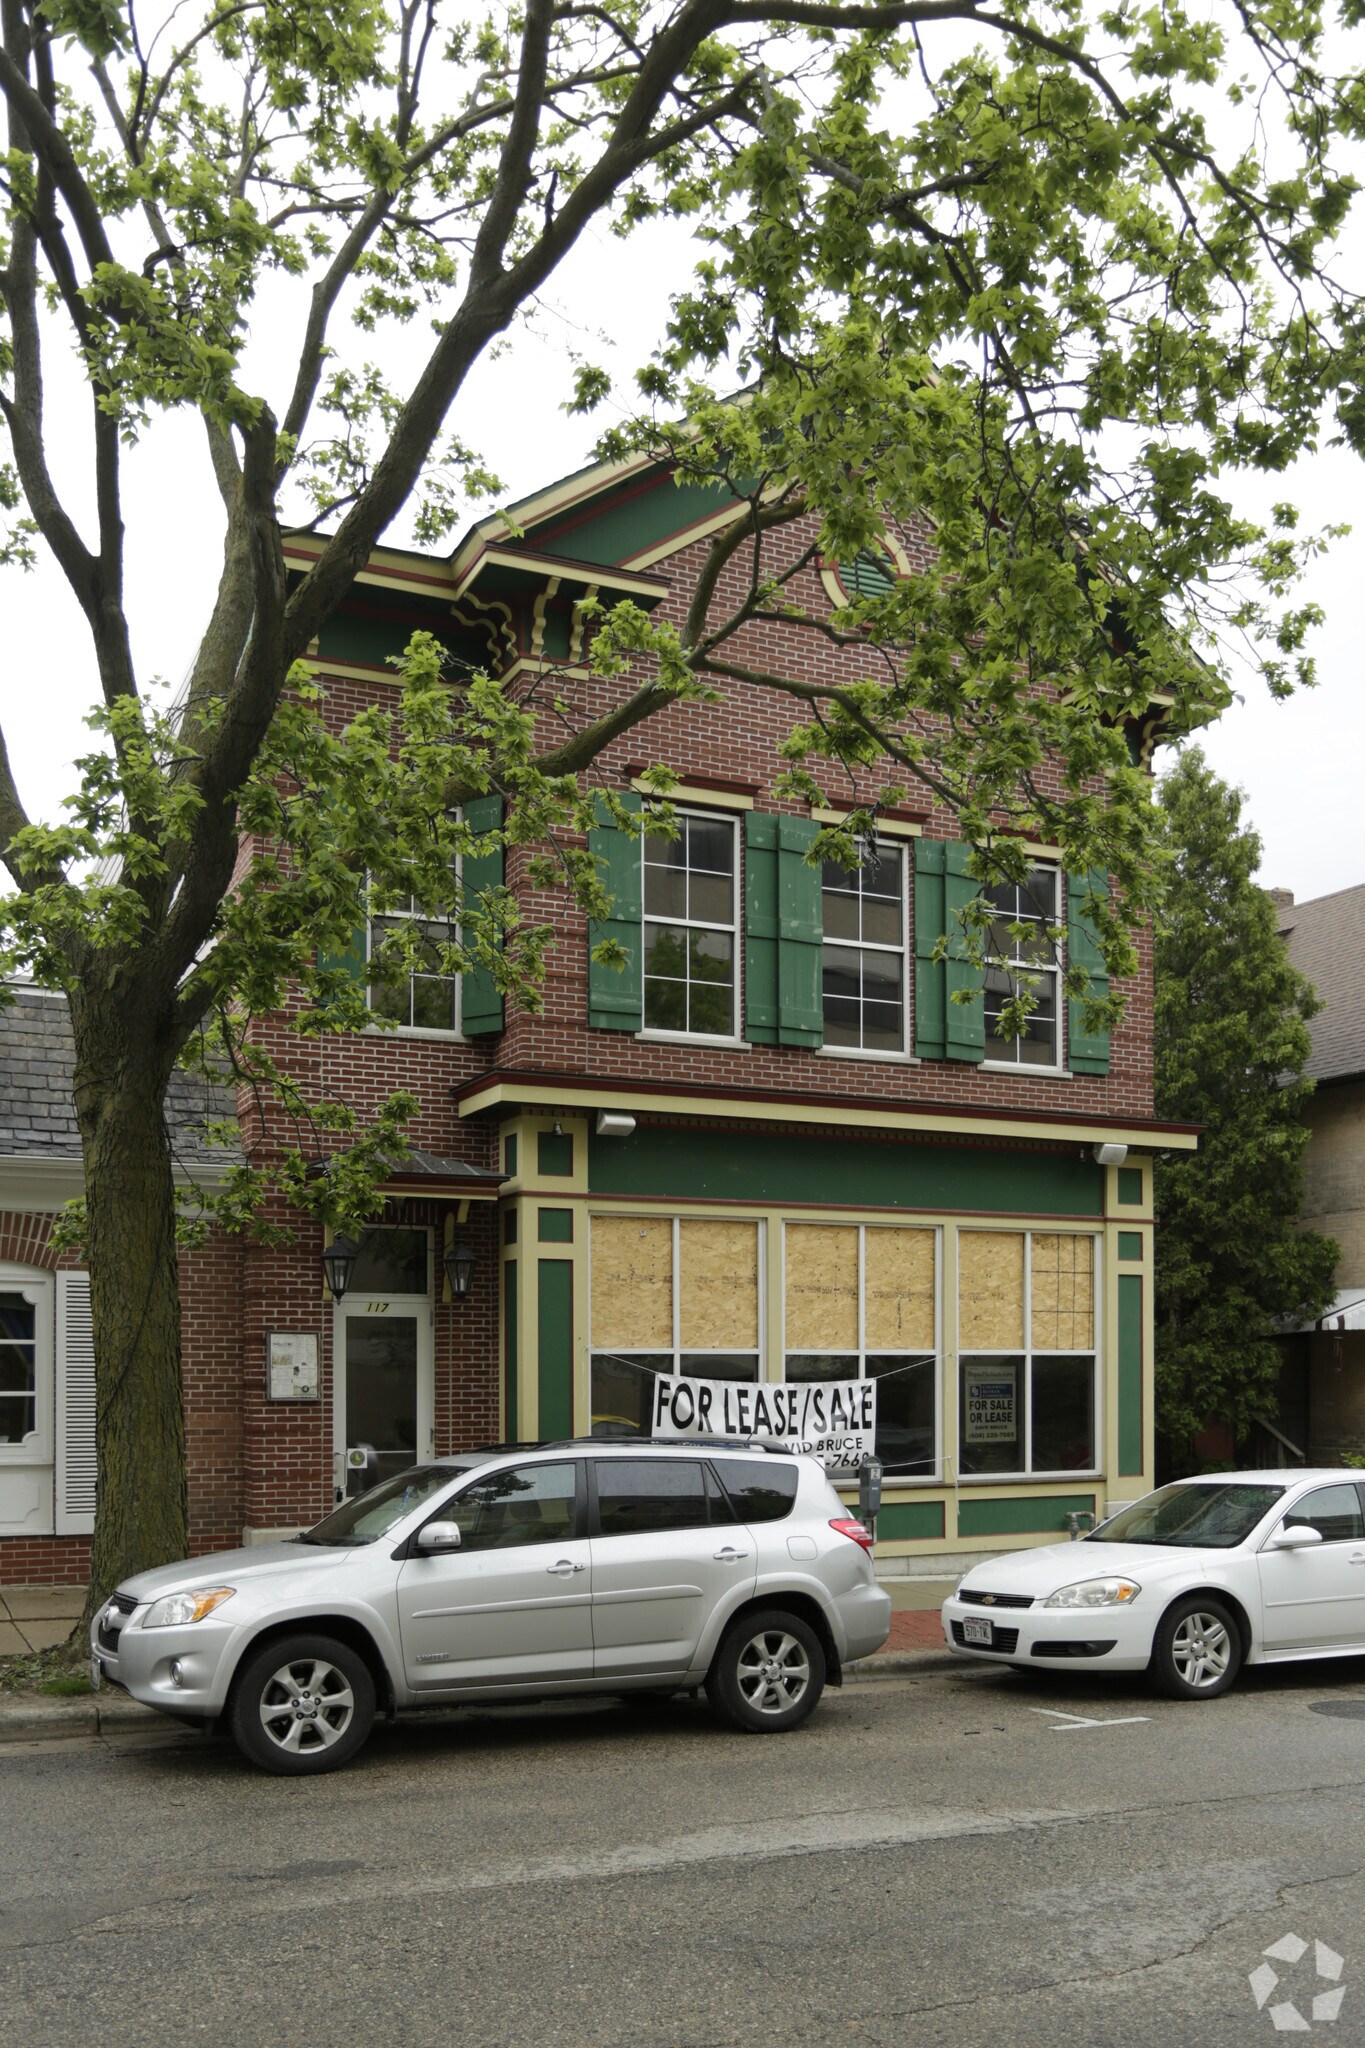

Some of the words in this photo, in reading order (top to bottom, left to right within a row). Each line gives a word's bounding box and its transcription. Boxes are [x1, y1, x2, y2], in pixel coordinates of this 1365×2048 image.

[367, 1303, 389, 1312] 117
[656, 1380, 713, 1433] FOR
[724, 1384, 872, 1440] LEASE/SALE
[969, 1400, 987, 1411] FOR
[990, 1400, 1013, 1410] SALE
[970, 1412, 982, 1423] OR
[985, 1412, 1012, 1422] LEASE
[784, 1442, 813, 1454] VID
[816, 1437, 863, 1452] BRUCE
